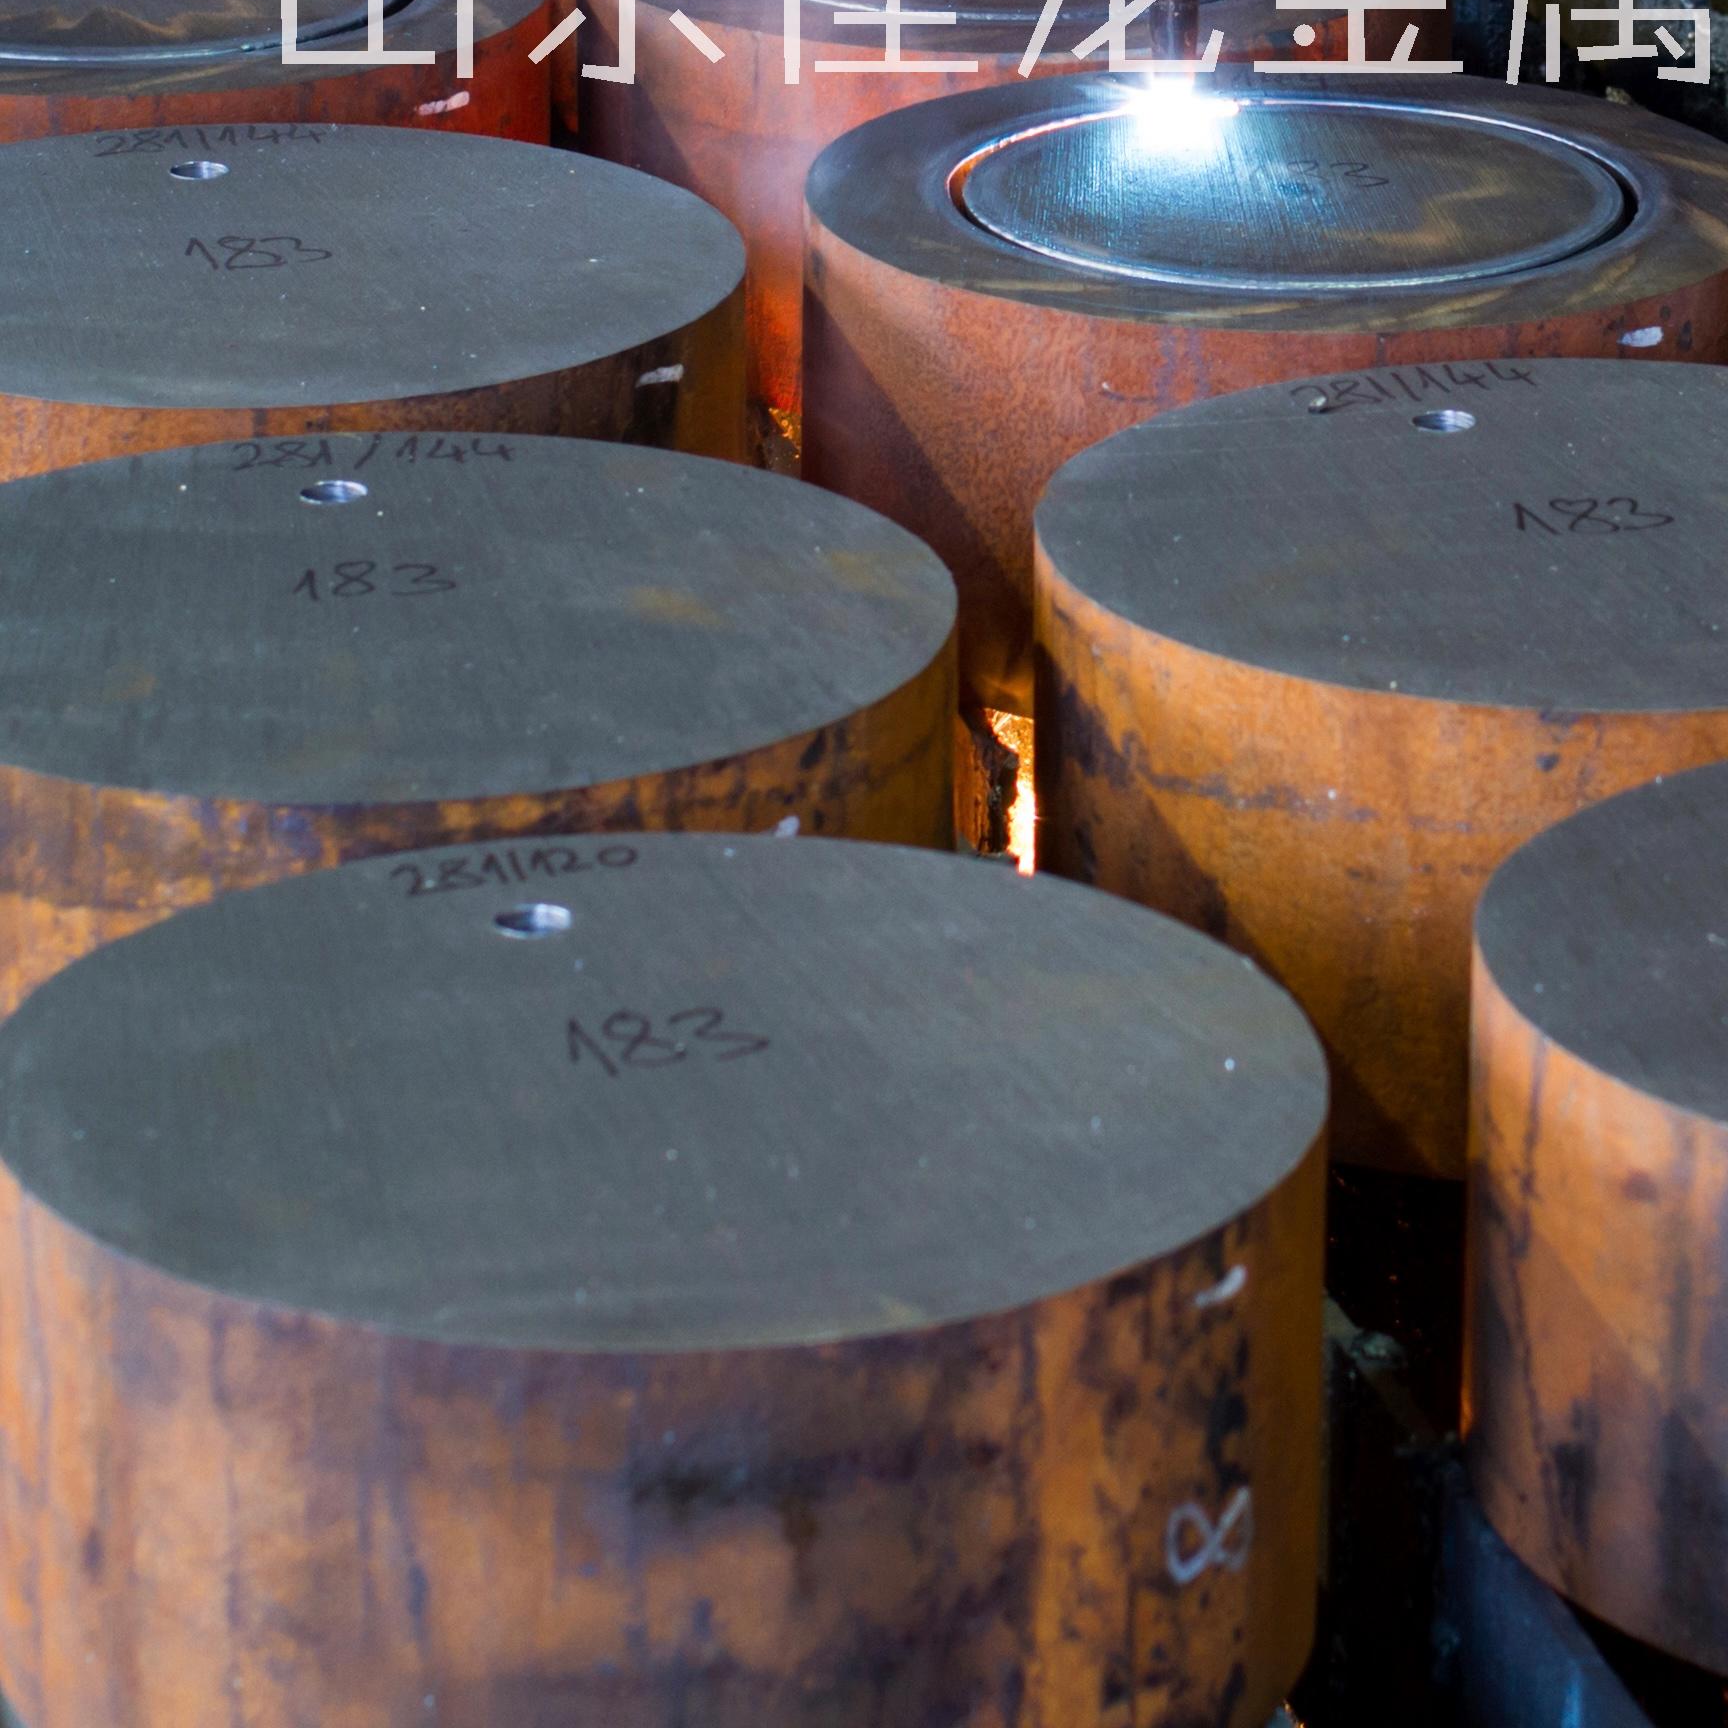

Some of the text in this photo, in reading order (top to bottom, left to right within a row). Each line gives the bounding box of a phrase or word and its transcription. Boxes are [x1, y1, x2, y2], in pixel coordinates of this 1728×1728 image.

[184, 235, 333, 271] 183
[1512, 496, 1675, 536] 183
[292, 560, 457, 602] 183
[566, 1006, 772, 1078] 183
